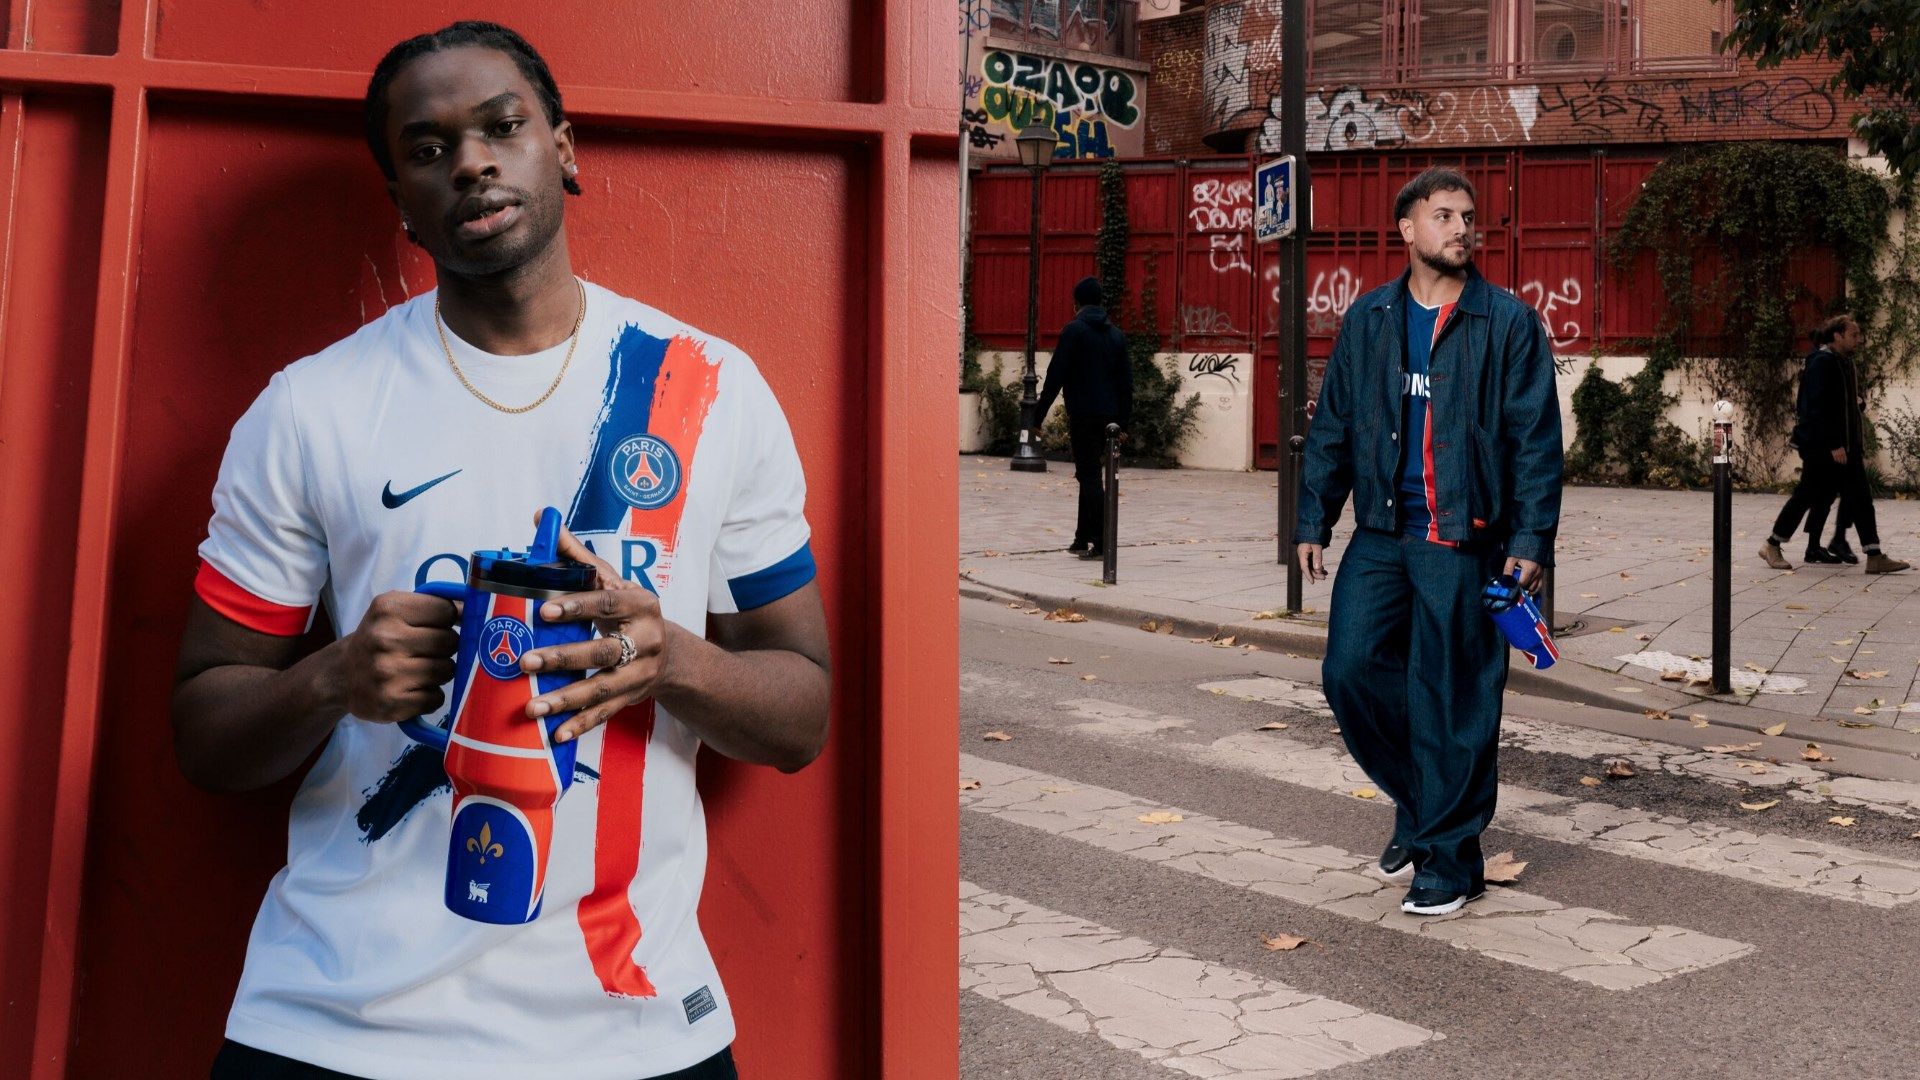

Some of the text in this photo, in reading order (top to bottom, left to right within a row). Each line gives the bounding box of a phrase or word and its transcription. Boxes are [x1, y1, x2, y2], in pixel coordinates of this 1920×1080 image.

[622, 441, 664, 458] PARIS
[623, 484, 666, 499] SAINT GERMAIN
[489, 620, 526, 638] PARIS
